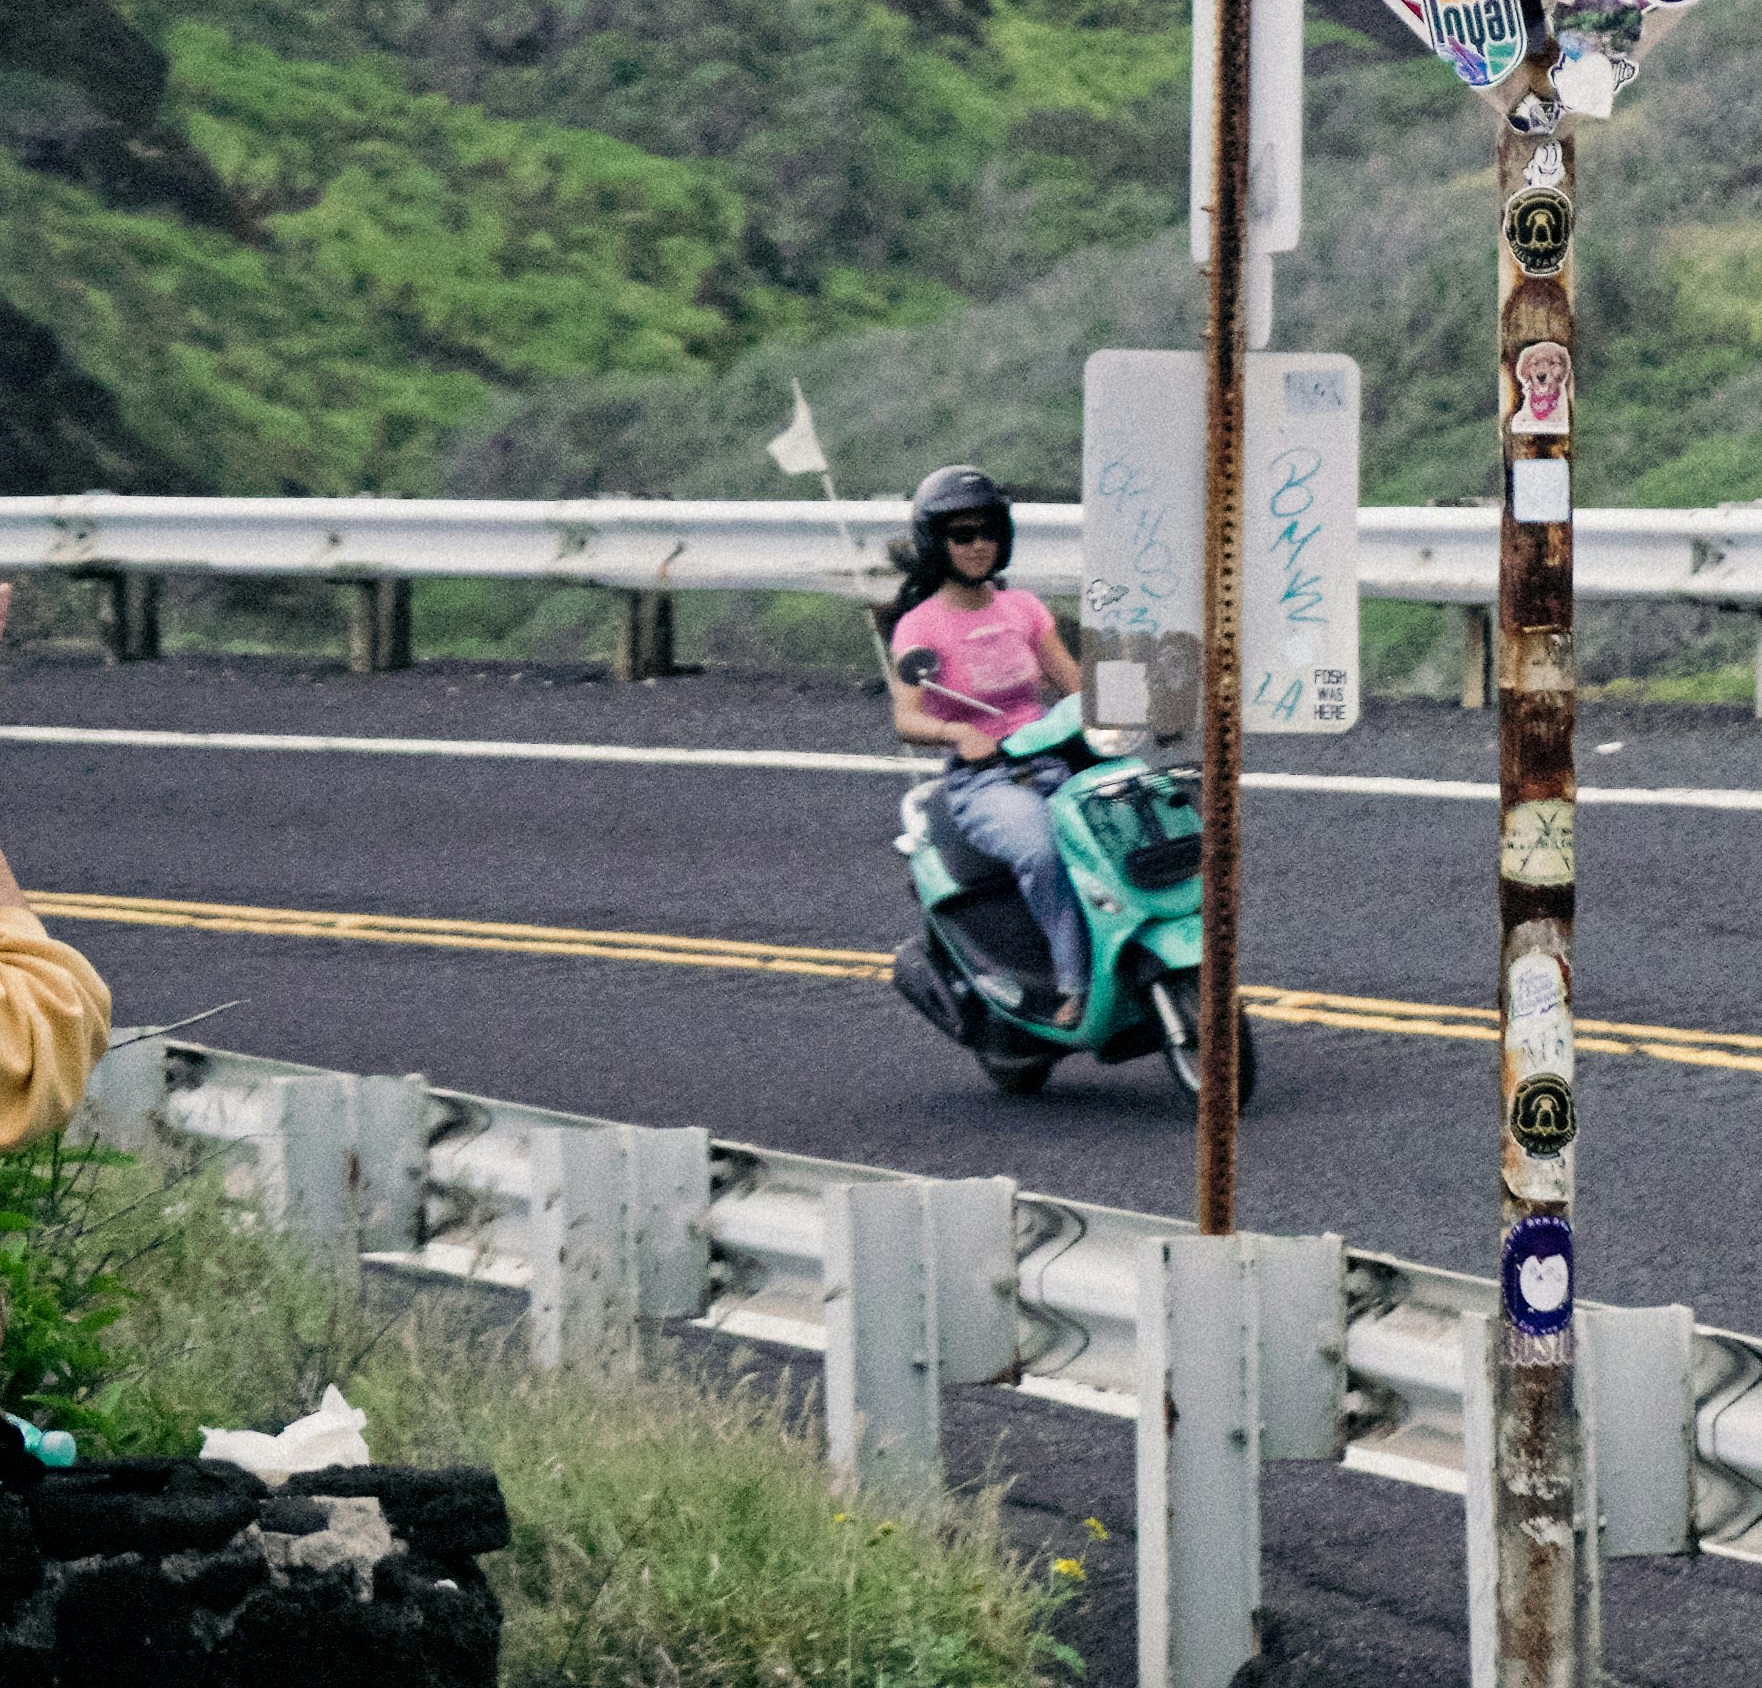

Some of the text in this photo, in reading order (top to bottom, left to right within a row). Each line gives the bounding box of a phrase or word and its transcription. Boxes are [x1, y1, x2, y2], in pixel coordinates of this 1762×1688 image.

[1313, 669, 1347, 685] FOSH
[1317, 686, 1344, 702] WAS
[1313, 704, 1347, 721] HERE
